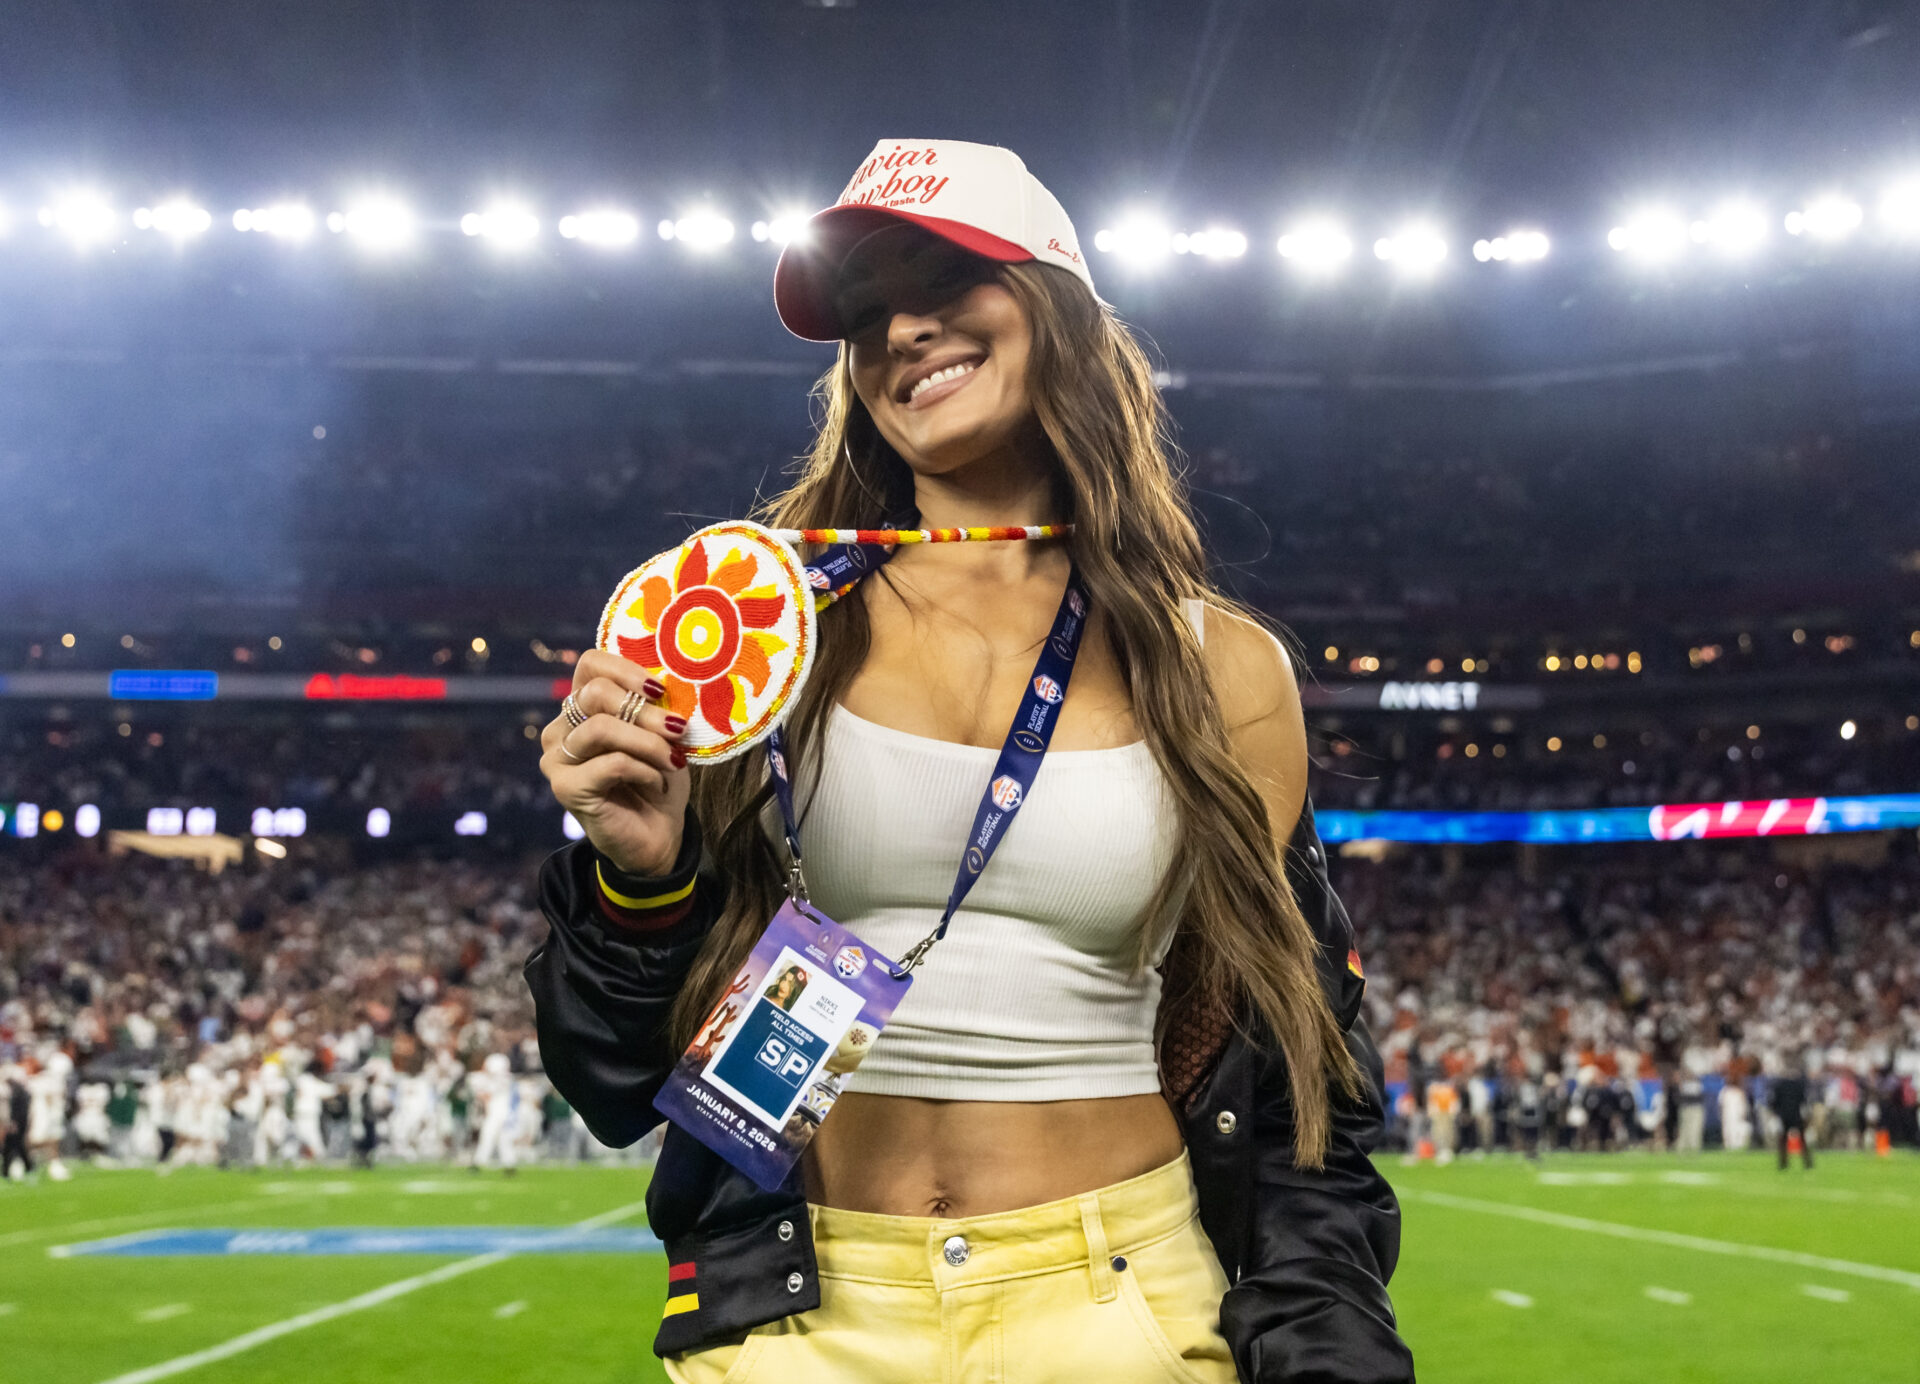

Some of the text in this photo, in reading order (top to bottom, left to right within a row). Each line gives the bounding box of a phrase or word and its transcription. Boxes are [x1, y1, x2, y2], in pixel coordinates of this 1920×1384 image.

[1027, 703, 1041, 730] PLAYOFF
[1034, 704, 1050, 733] SEMIFINAL
[977, 812, 993, 846] PLAYOFF
[981, 812, 1003, 850] SEMIFINAL
[769, 1009, 791, 1026] FIELD
[788, 1023, 815, 1043] ACCESS
[771, 1020, 805, 1046] ALL TIMES
[686, 1084, 738, 1123] JANUARY
[747, 1127, 777, 1152] 2026
[696, 1104, 713, 1119] STATE
[729, 1129, 754, 1149] STADIUM
